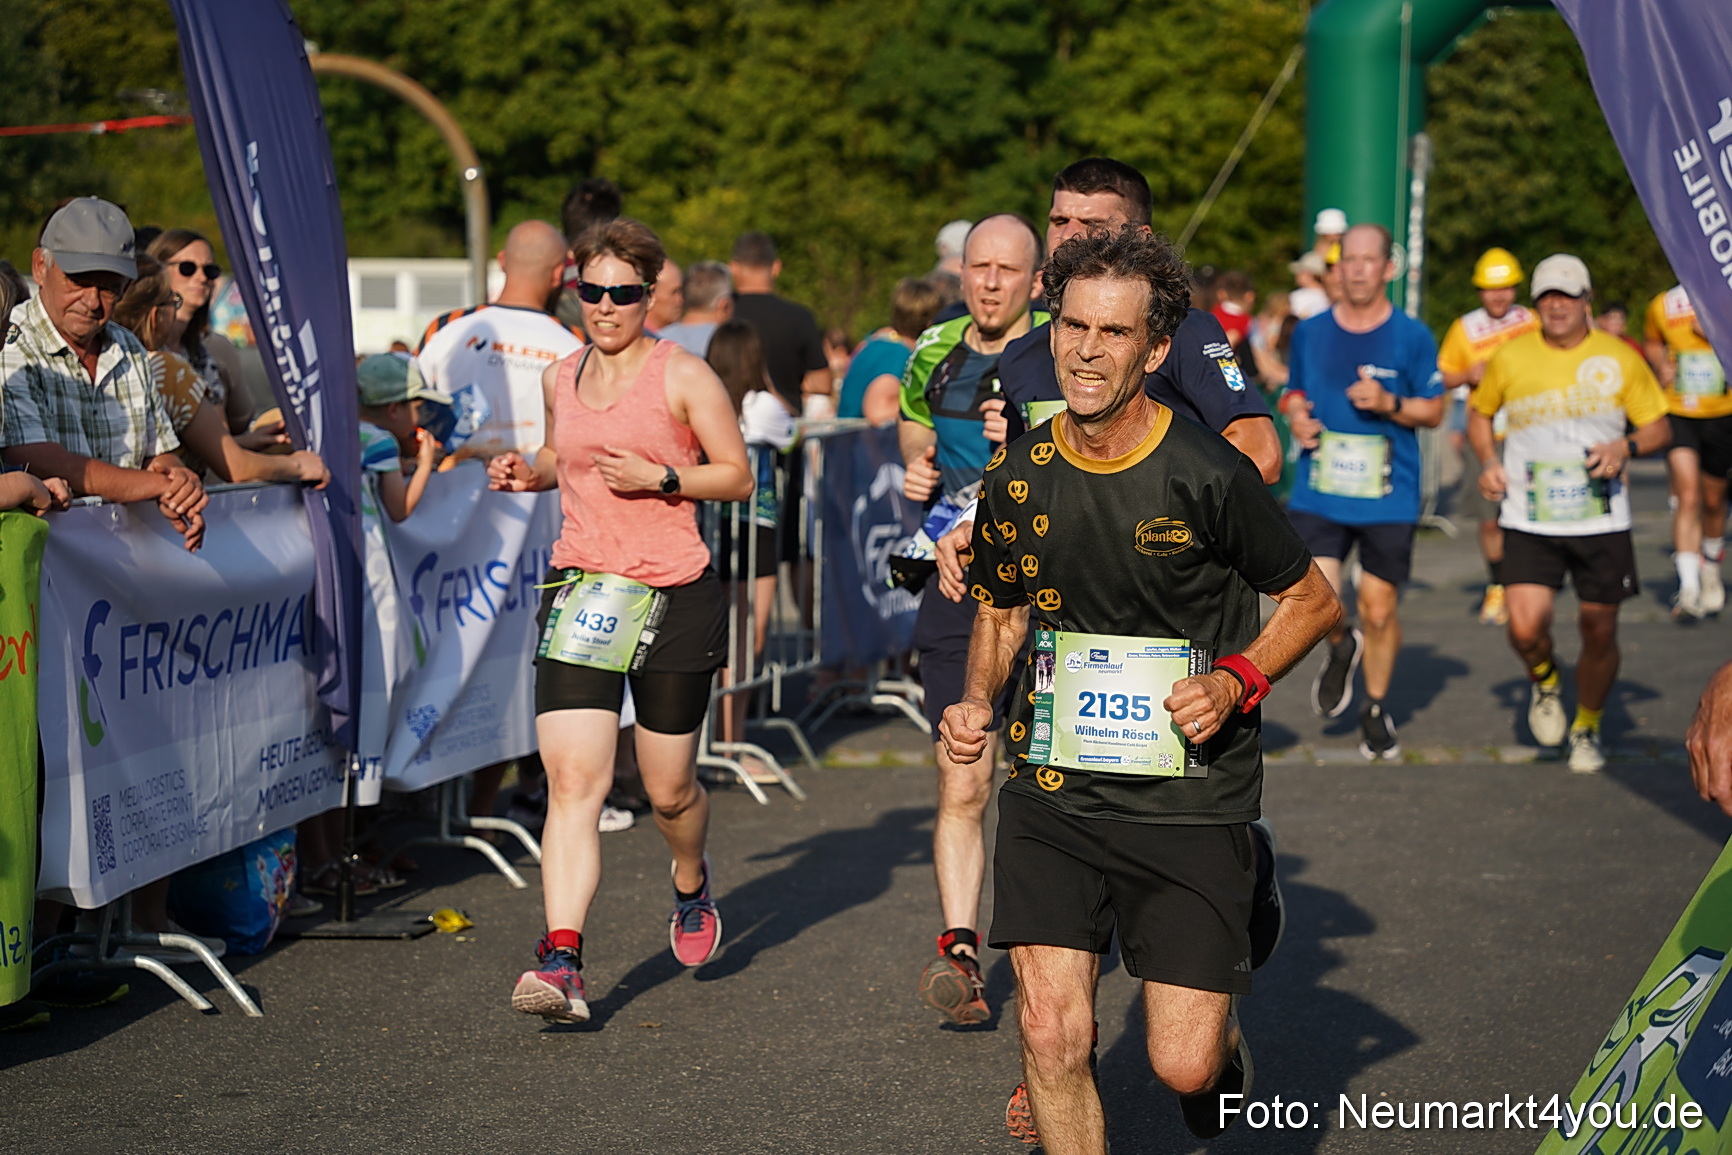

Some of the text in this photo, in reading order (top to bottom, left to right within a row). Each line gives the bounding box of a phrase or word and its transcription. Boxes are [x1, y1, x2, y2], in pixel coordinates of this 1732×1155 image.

[1141, 529, 1174, 546] plank
[574, 609, 618, 634] 433
[1038, 640, 1054, 648] AOK
[1084, 662, 1124, 670] Firmenlauf
[1078, 691, 1151, 722] 2135
[1075, 725, 1158, 741] Wilhelm Rösch
[260, 737, 301, 772] HEUTE
[257, 774, 305, 814] MORGEN
